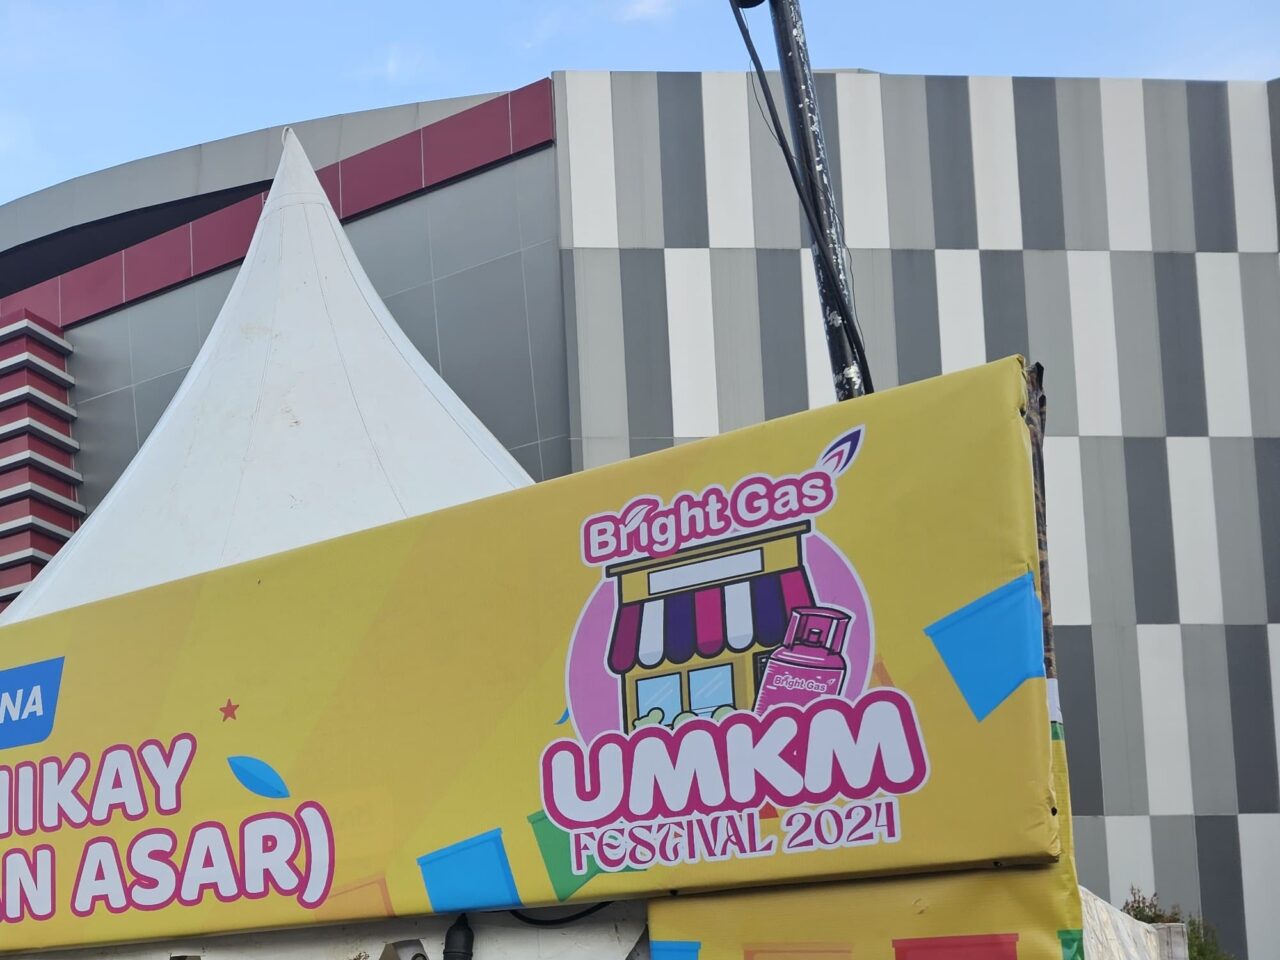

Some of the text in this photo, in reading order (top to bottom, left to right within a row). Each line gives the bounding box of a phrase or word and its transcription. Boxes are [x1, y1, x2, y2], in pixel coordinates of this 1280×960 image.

[587, 473, 832, 561] Bright Gas
[774, 675, 827, 692] Bright Gas
[544, 690, 926, 826] UMKM
[74, 801, 334, 916] ASAR)
[573, 801, 899, 872] FESTIVAL 2024
